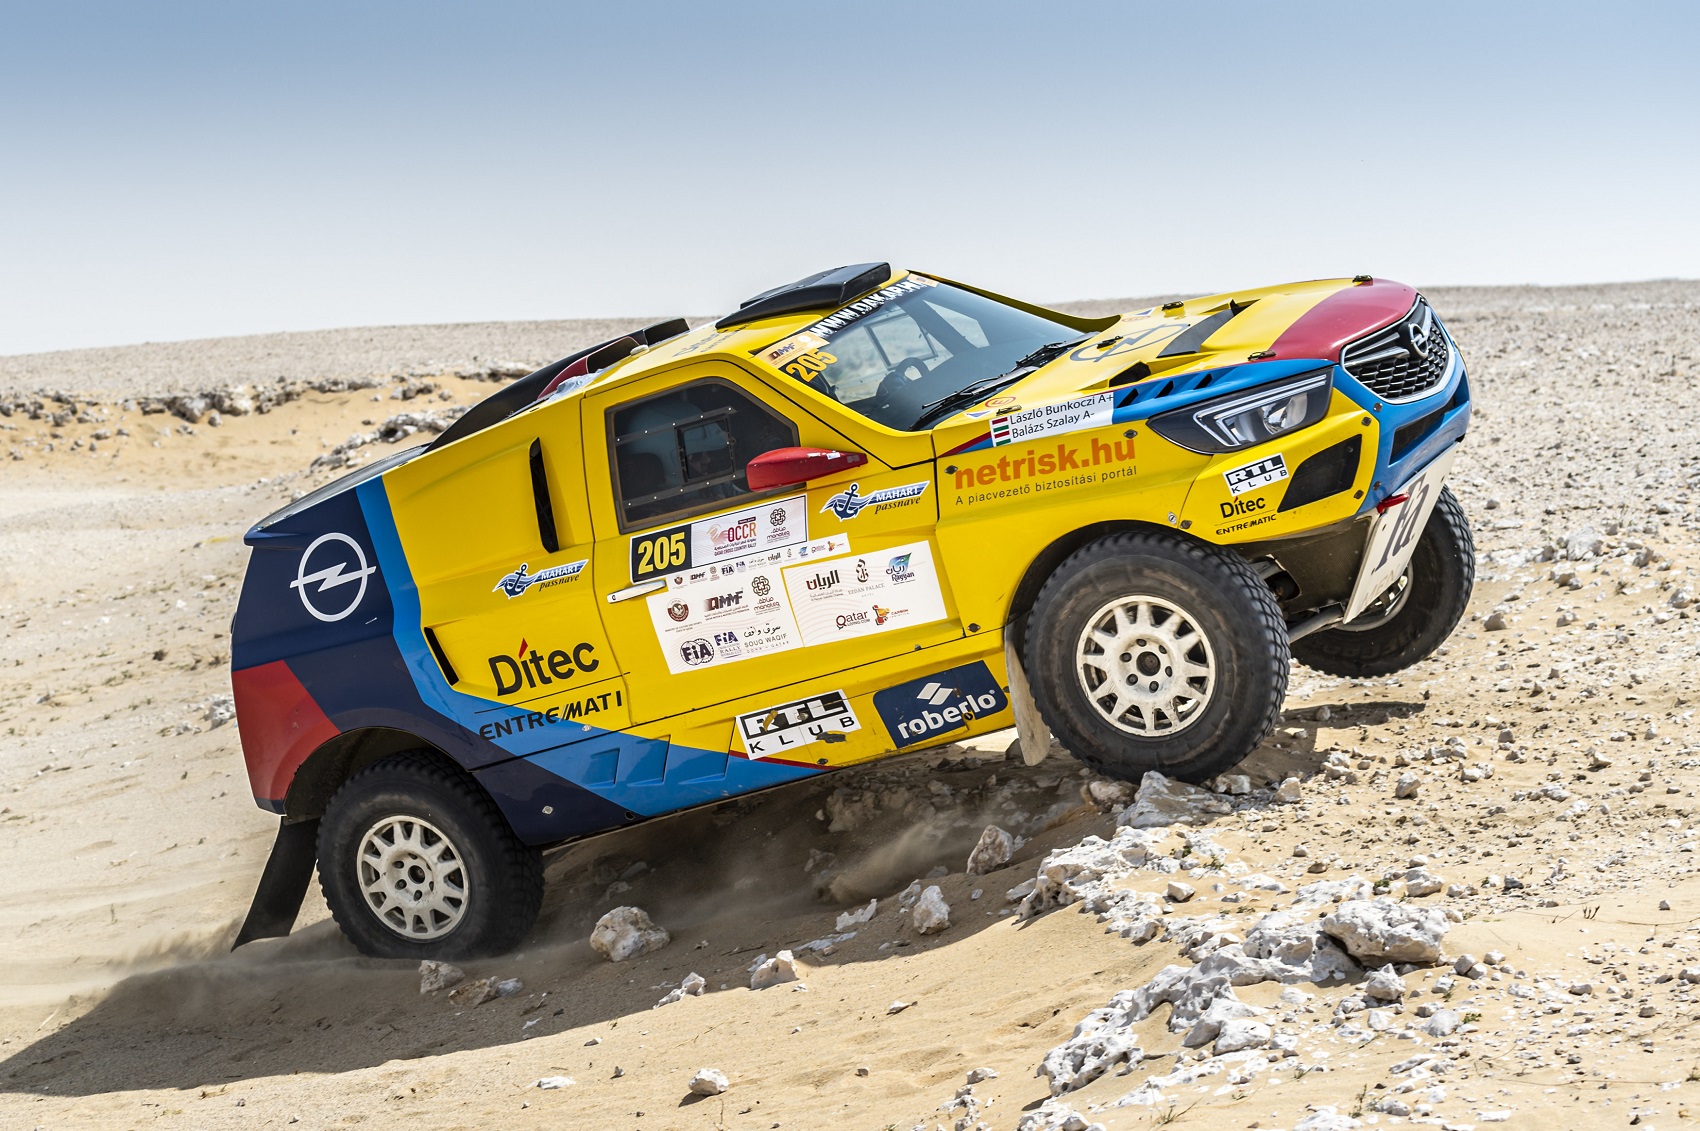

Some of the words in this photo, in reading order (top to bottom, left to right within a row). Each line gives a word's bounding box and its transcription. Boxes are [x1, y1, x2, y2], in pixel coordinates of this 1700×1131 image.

[785, 348, 838, 383] 205
[1009, 407, 1044, 426] László
[1045, 396, 1096, 416] Bunkoczi
[1098, 393, 1114, 405] A+
[1012, 421, 1045, 439] Balázs
[1047, 414, 1081, 430] Szalay
[1082, 410, 1095, 422] A-
[955, 437, 1137, 490] netrisk.hu
[1230, 457, 1284, 485] RTL
[874, 484, 920, 502] MAHART
[955, 495, 963, 505] A
[968, 483, 1031, 506] piacvezető
[1035, 471, 1097, 493] biztosítási
[1101, 465, 1138, 483] portál
[1231, 469, 1289, 495] KLUB
[874, 496, 921, 515] passnave
[727, 521, 757, 543] QCCR
[637, 531, 686, 575] 205
[538, 574, 580, 592] passnave
[540, 563, 580, 580] MAHART
[806, 569, 841, 591] الريان
[836, 611, 868, 628] Qatar
[744, 639, 764, 649] SOUQ
[765, 633, 787, 644] WAQIF
[744, 699, 844, 736] RTL
[897, 693, 998, 739] roberlo
[748, 716, 856, 754] KLUB
